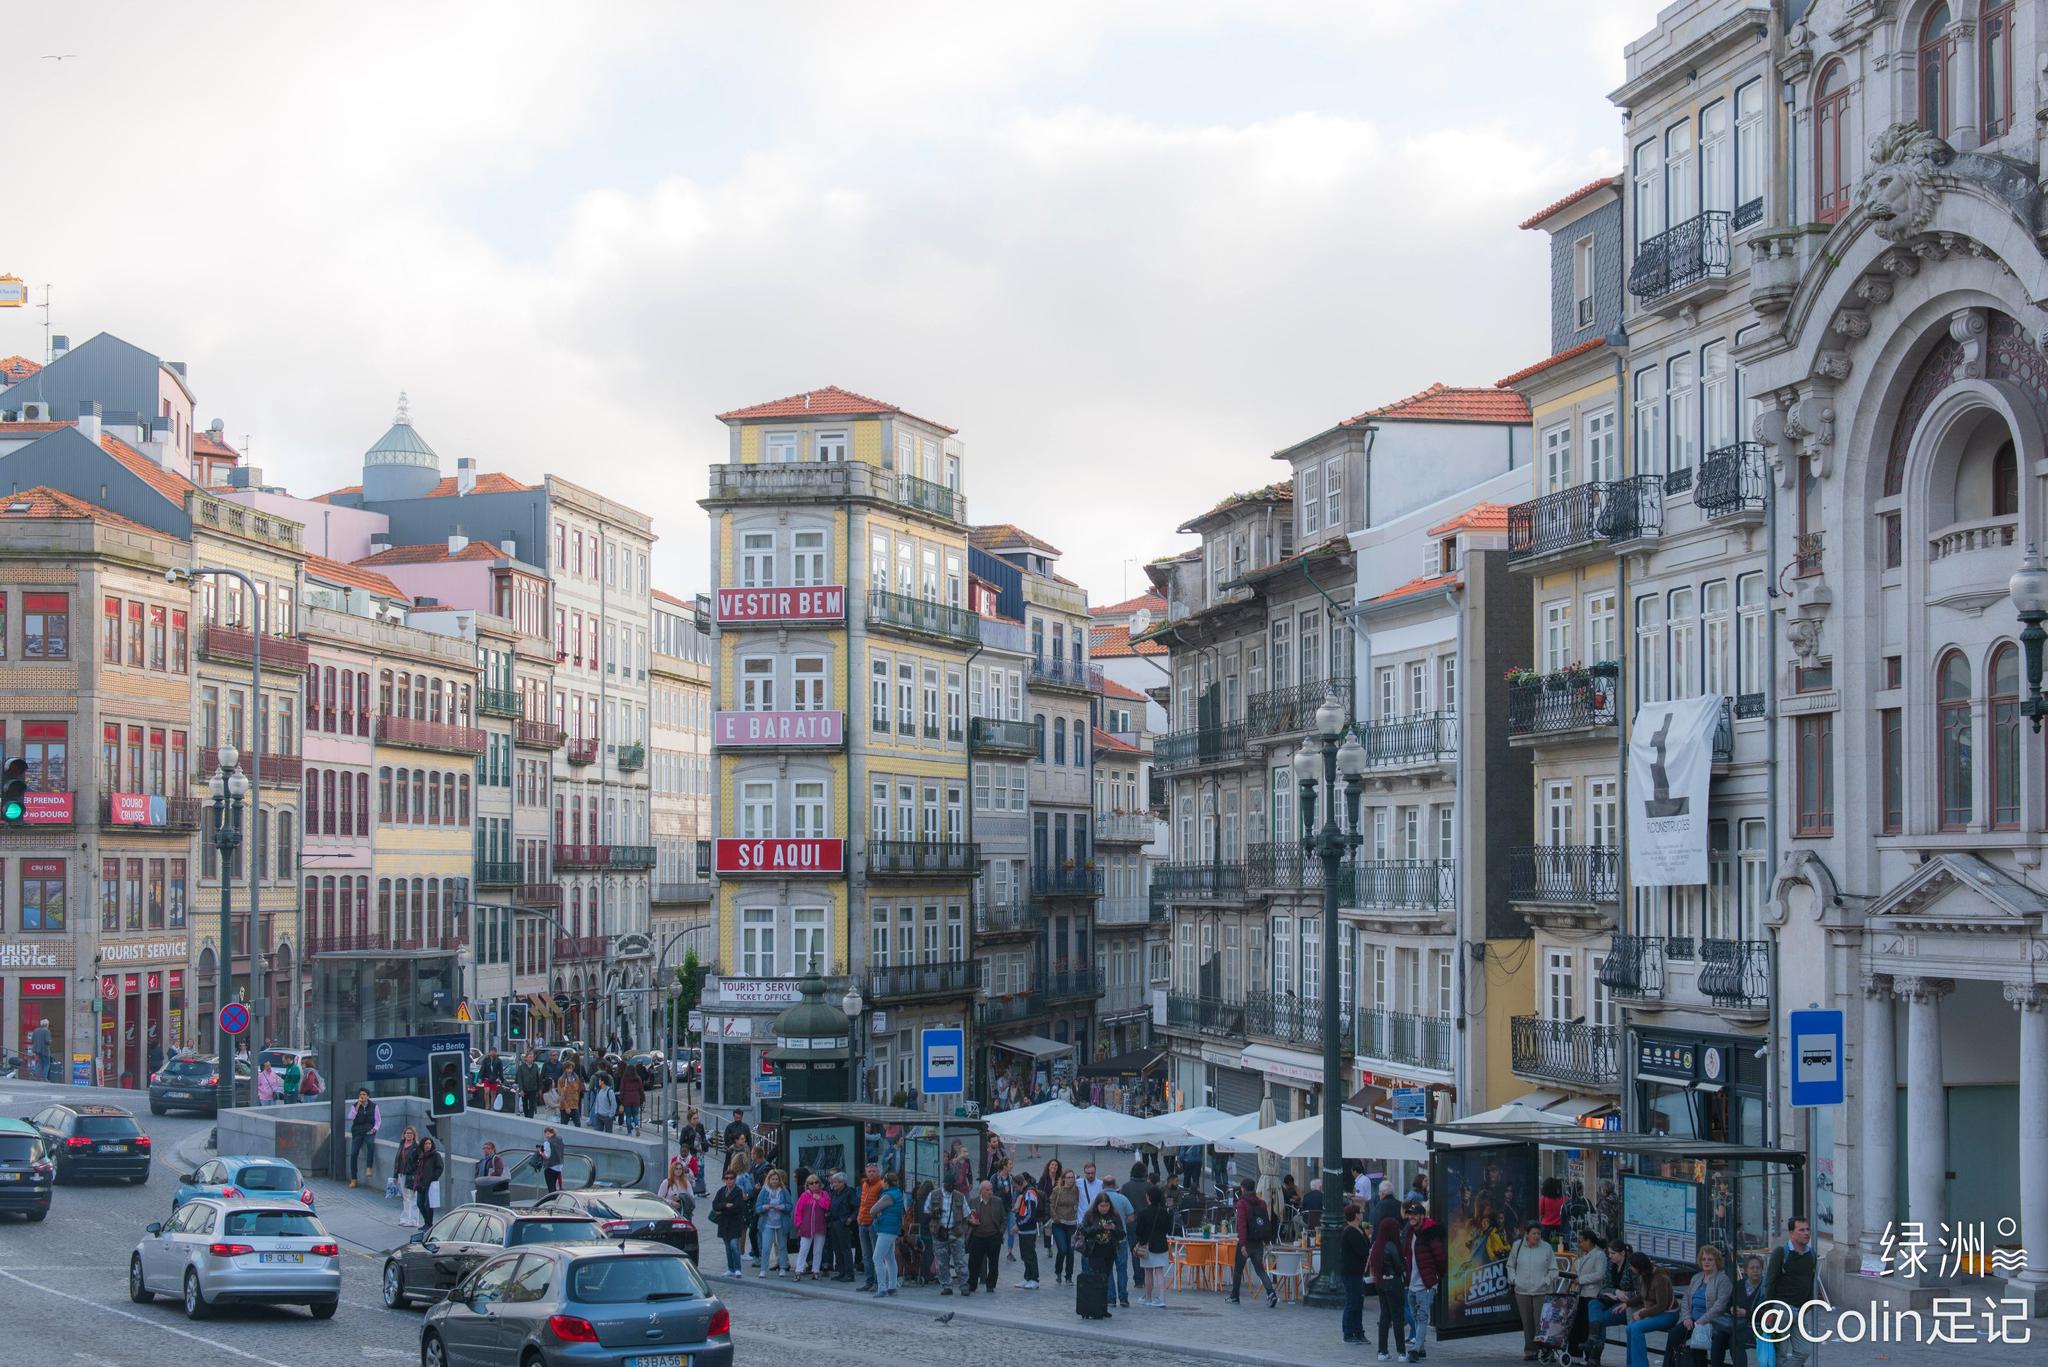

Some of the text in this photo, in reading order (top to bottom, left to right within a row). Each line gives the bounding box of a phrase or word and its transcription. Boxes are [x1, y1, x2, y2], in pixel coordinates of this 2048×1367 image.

[720, 591, 841, 616] VESTIR BEM
[726, 716, 832, 739] E BARATO
[33, 796, 65, 804] PRENDA
[121, 797, 143, 809] DOURO
[40, 810, 69, 819] DOURO
[121, 810, 145, 821] CRUISES
[738, 840, 821, 866] SÓ AQUI
[100, 941, 187, 960] TOURIST SERVICE
[722, 982, 801, 992] TOURIST SERVIC
[735, 993, 792, 1001] TICKET OFFICE
[431, 1041, 465, 1051] São Bento
[375, 1062, 394, 1071] metro
[806, 1133, 838, 1143] Salsa
[1471, 1262, 1504, 1286] HAN
[1467, 1275, 1508, 1300] SOLO
